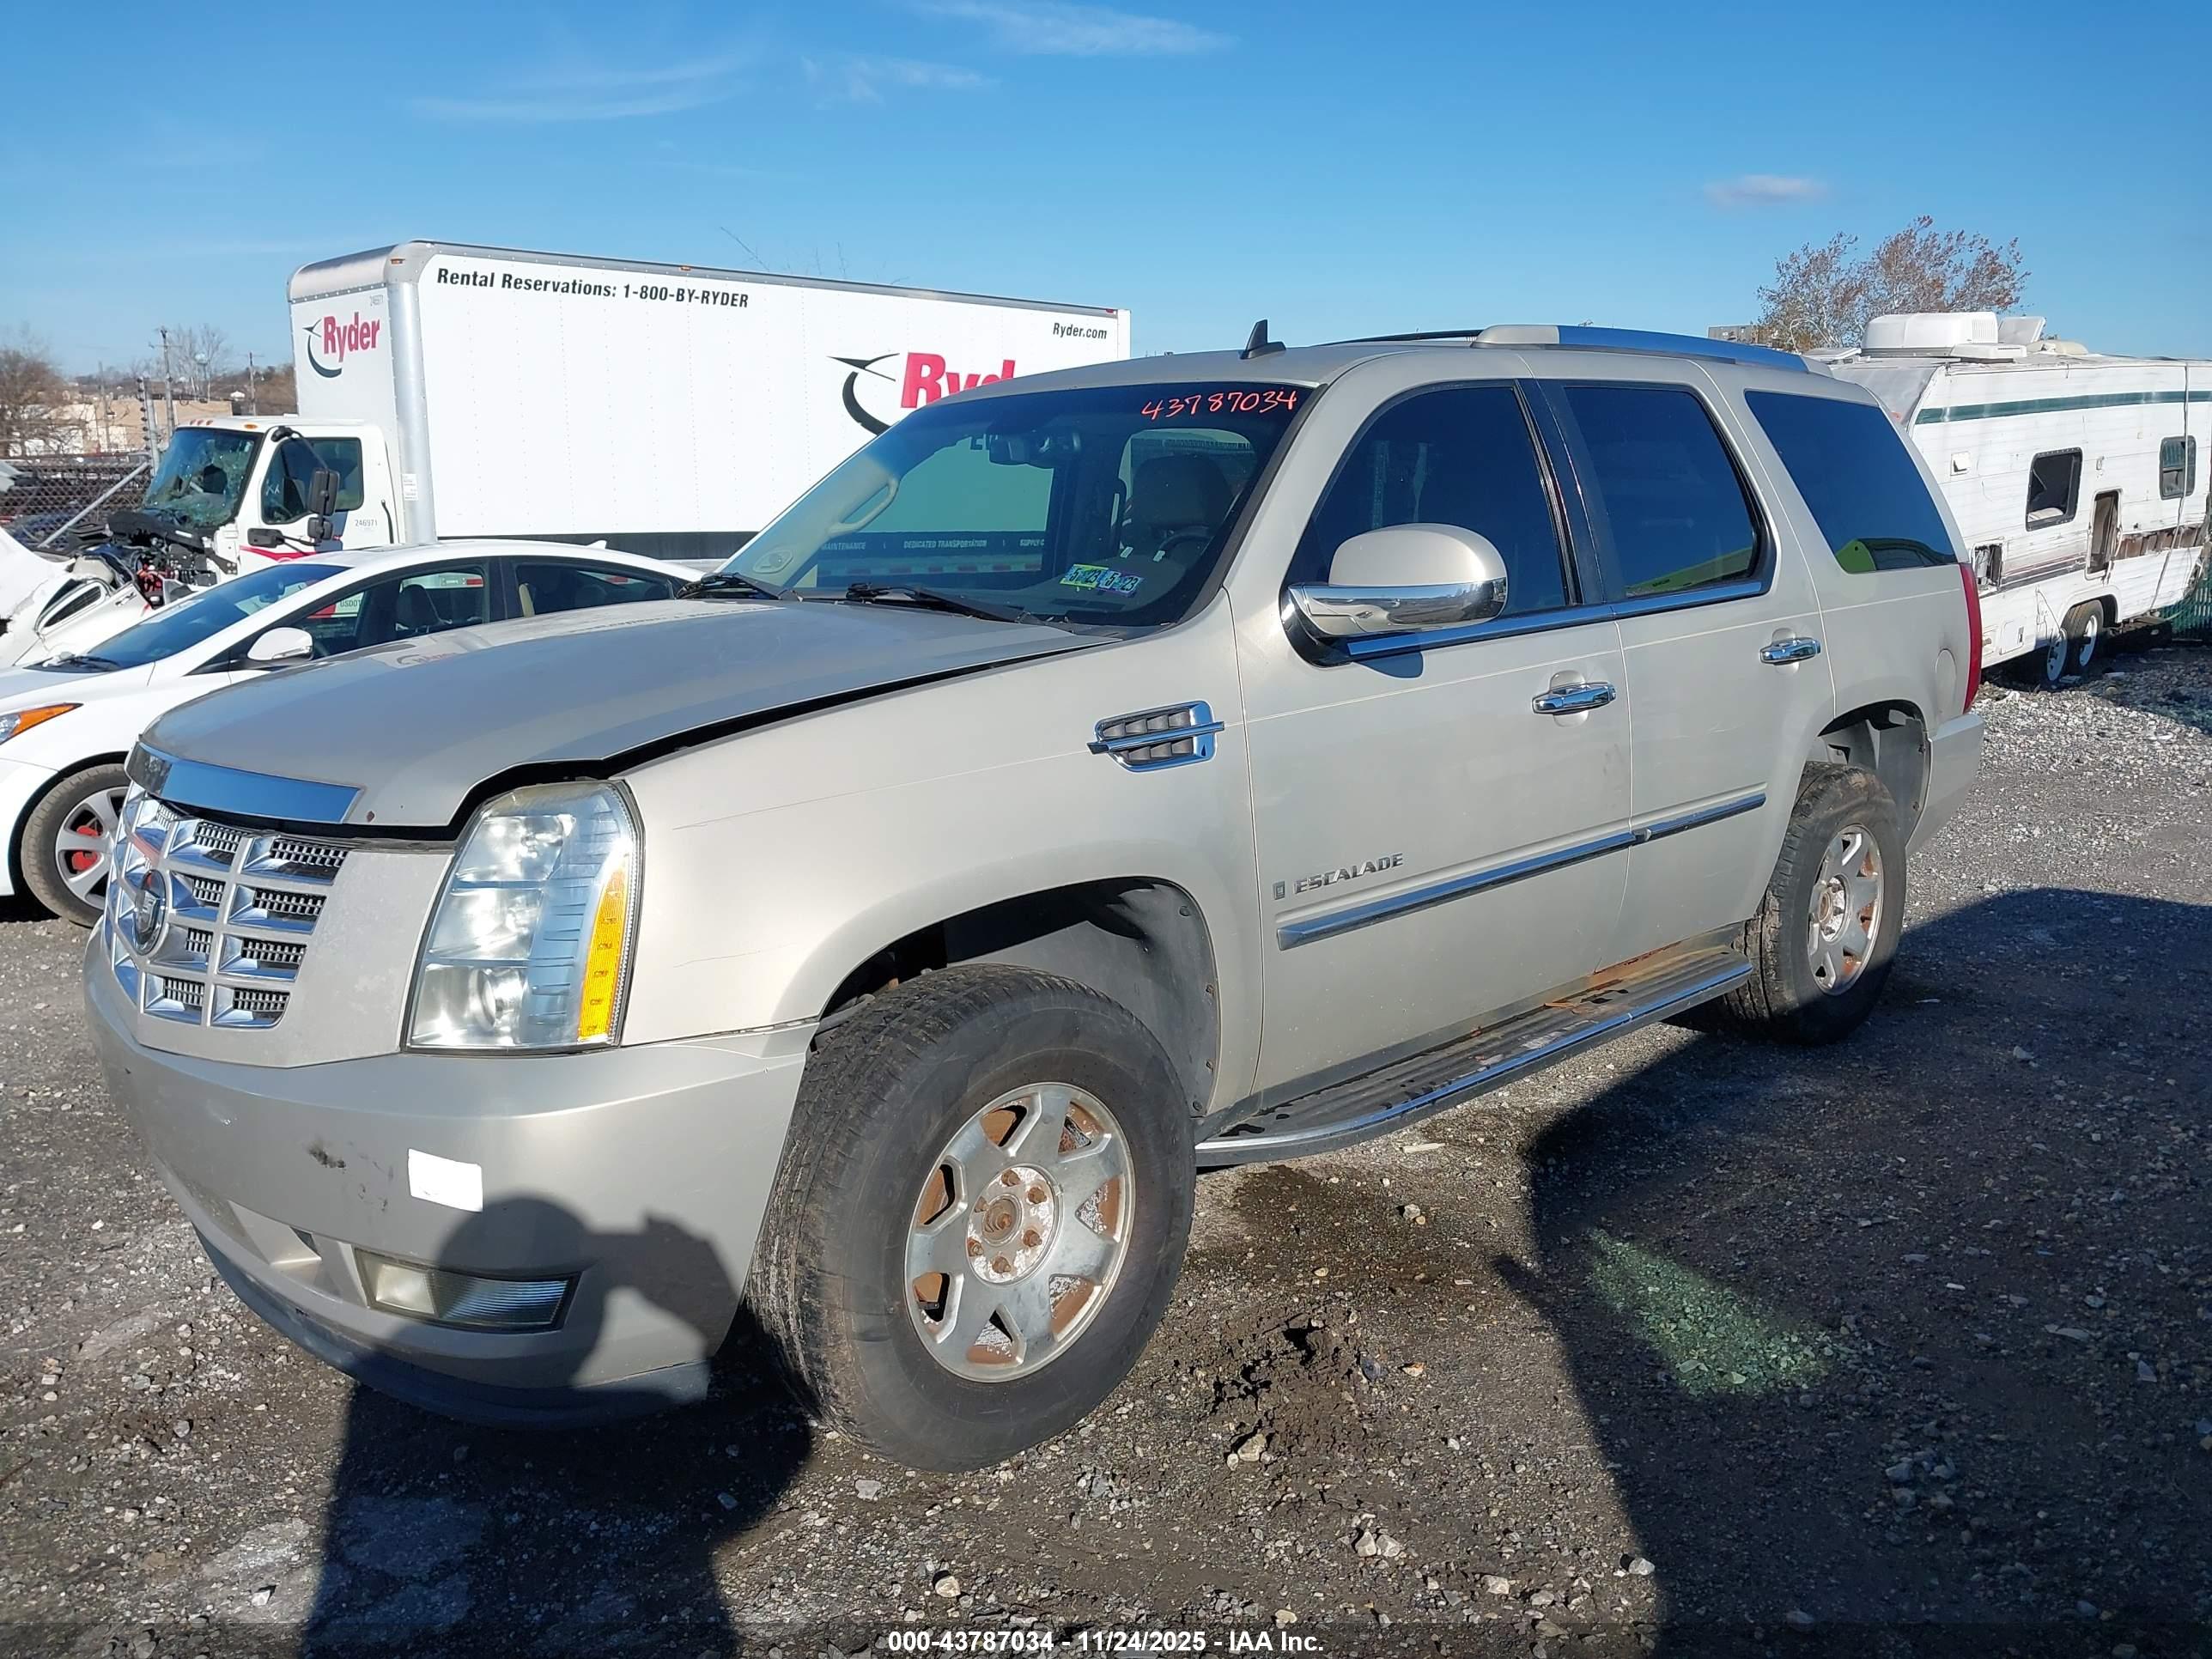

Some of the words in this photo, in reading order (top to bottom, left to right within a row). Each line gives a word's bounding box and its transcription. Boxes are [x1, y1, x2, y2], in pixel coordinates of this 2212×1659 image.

[437, 268, 495, 288] Rental
[501, 273, 617, 297] Reservations:
[623, 283, 749, 307] 1-800-BY-RYDER
[323, 311, 380, 363] Ryder
[1053, 322, 1108, 339] Ryder.com
[1140, 389, 1297, 421] 43787034
[903, 539, 936, 550] DEDICATED
[1069, 568, 1082, 582] 5
[1104, 572, 1119, 586] 5
[1119, 576, 1139, 592] 23
[1292, 852, 1404, 895] ESCALADE
